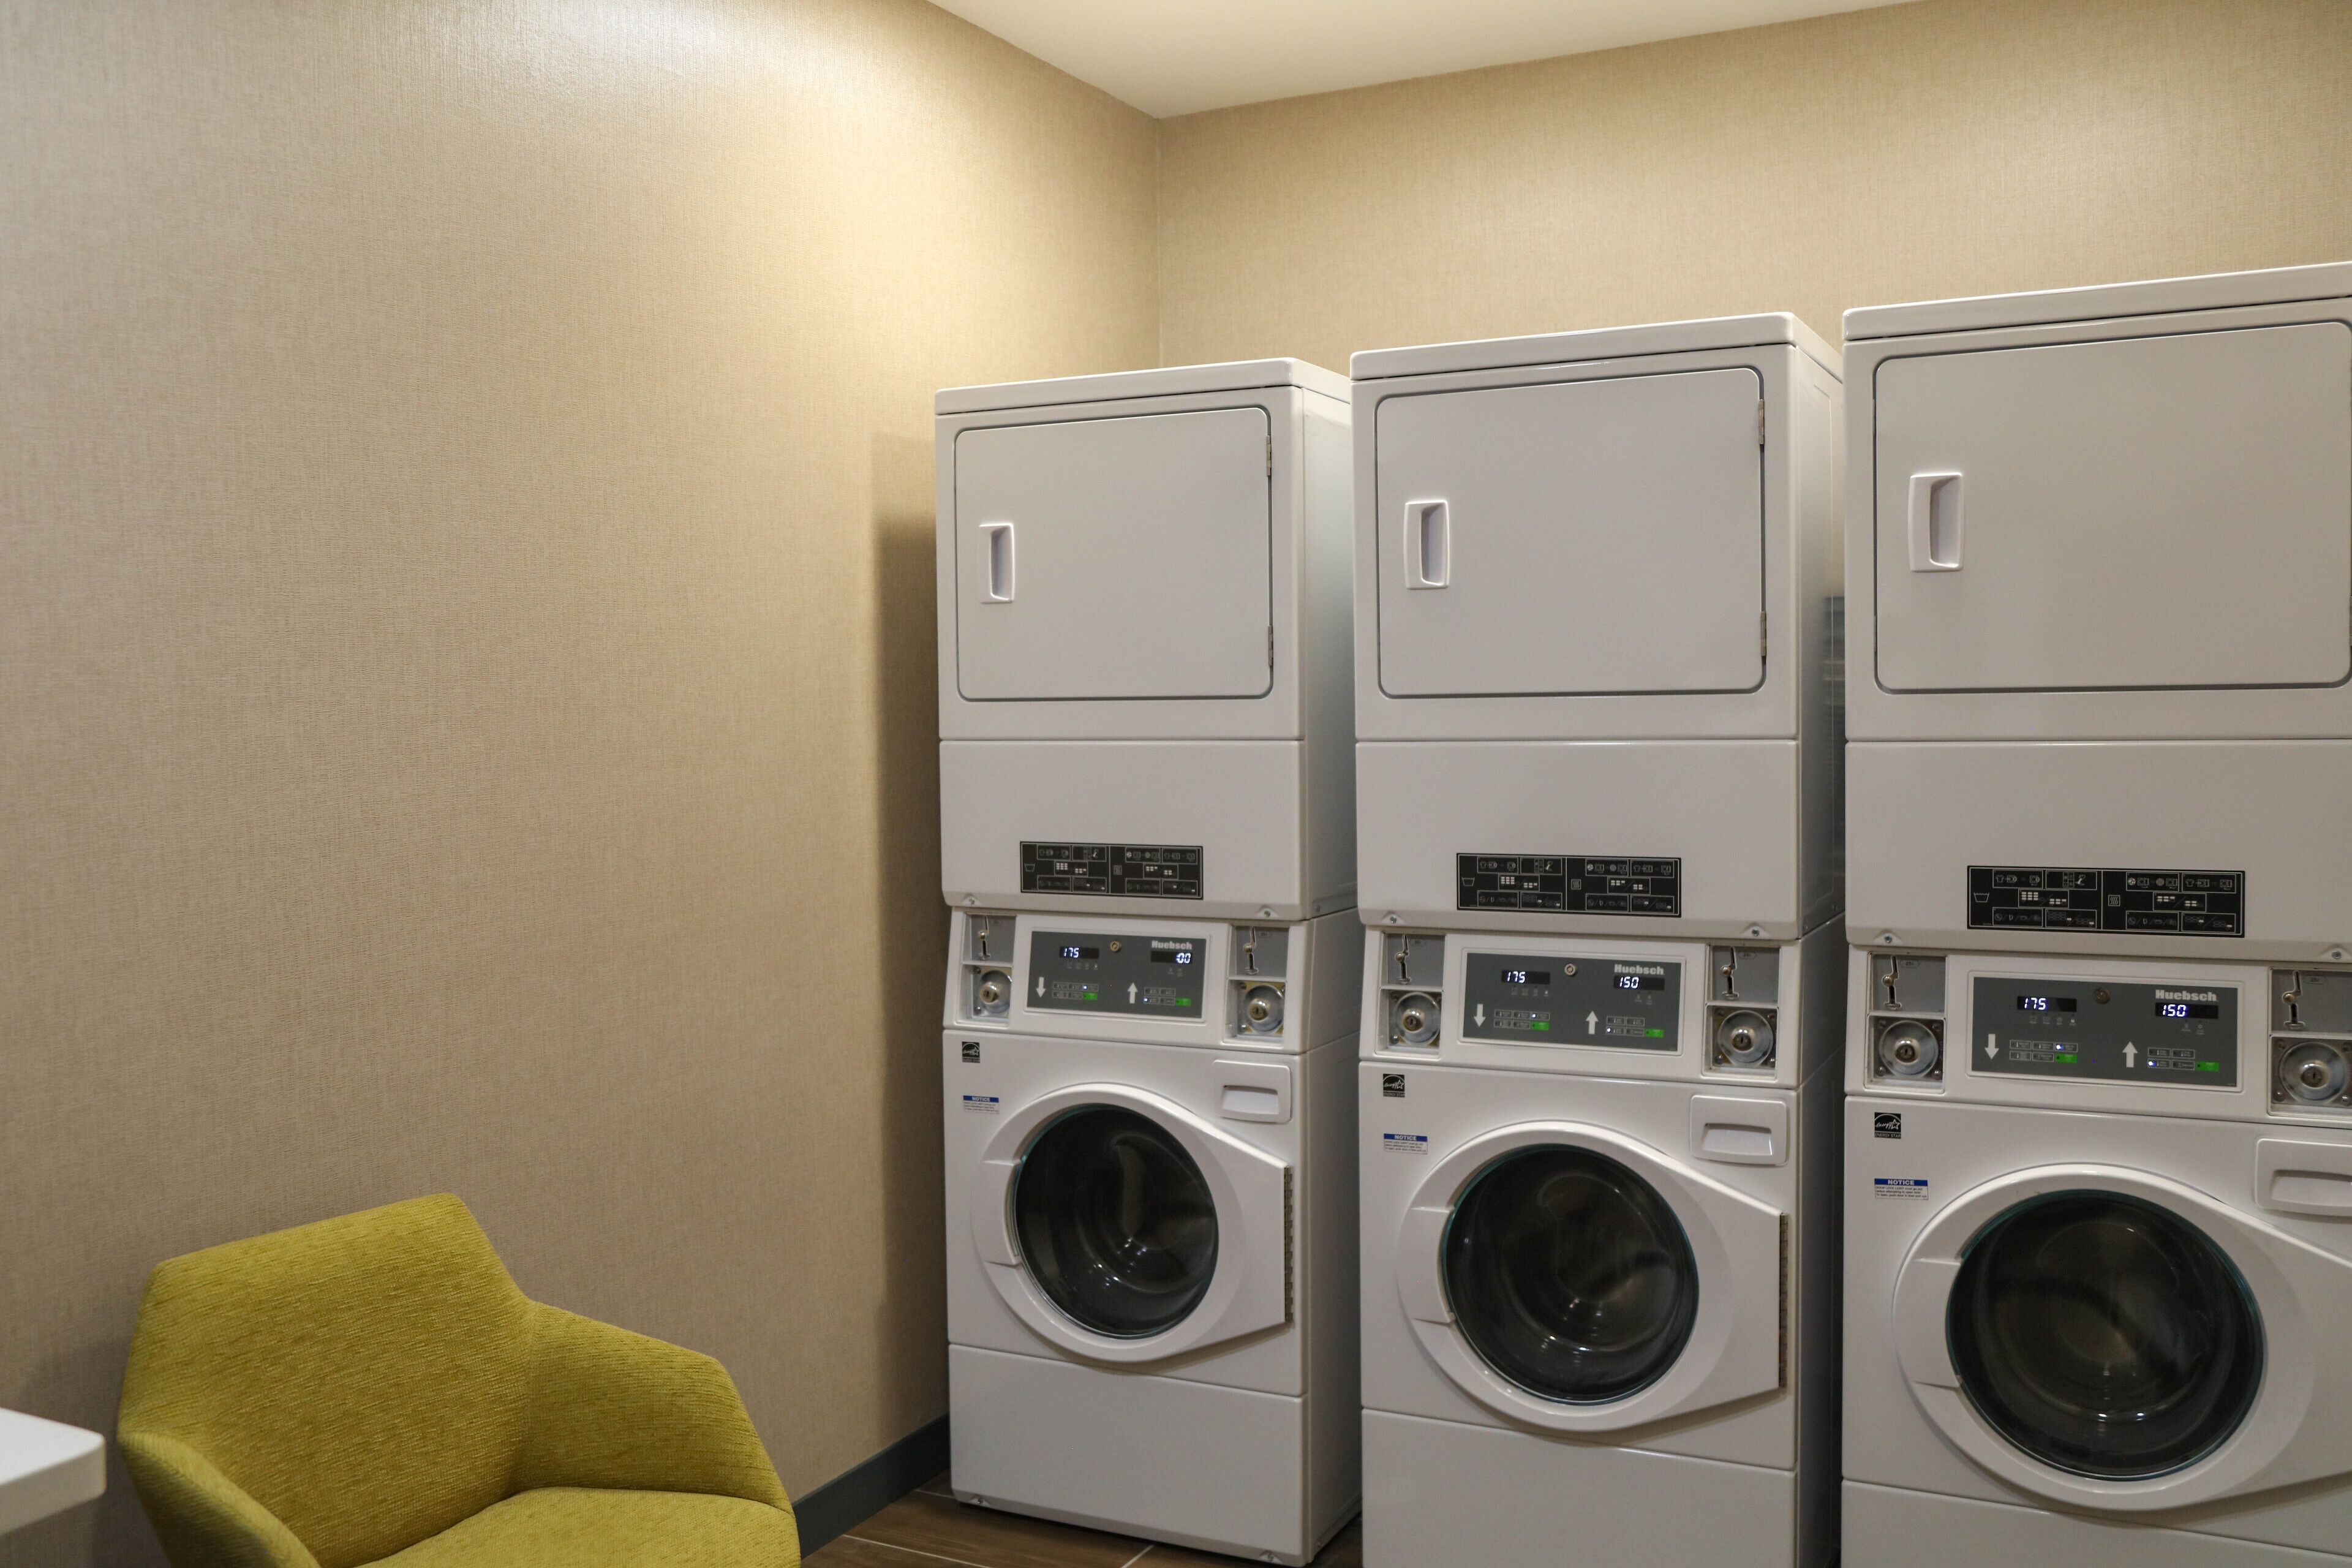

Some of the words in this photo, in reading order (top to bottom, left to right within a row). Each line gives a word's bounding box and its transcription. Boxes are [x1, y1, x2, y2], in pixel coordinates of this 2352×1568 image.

[1152, 940, 1192, 950] Huebsch
[1064, 947, 1079, 958] 175
[1614, 964, 1664, 975] Huebsch
[1507, 971, 1525, 983] 175
[1619, 976, 1639, 988] 150
[2155, 989, 2217, 1001] Huebsch
[2024, 997, 2046, 1010] 175
[2162, 1004, 2186, 1017] 150
